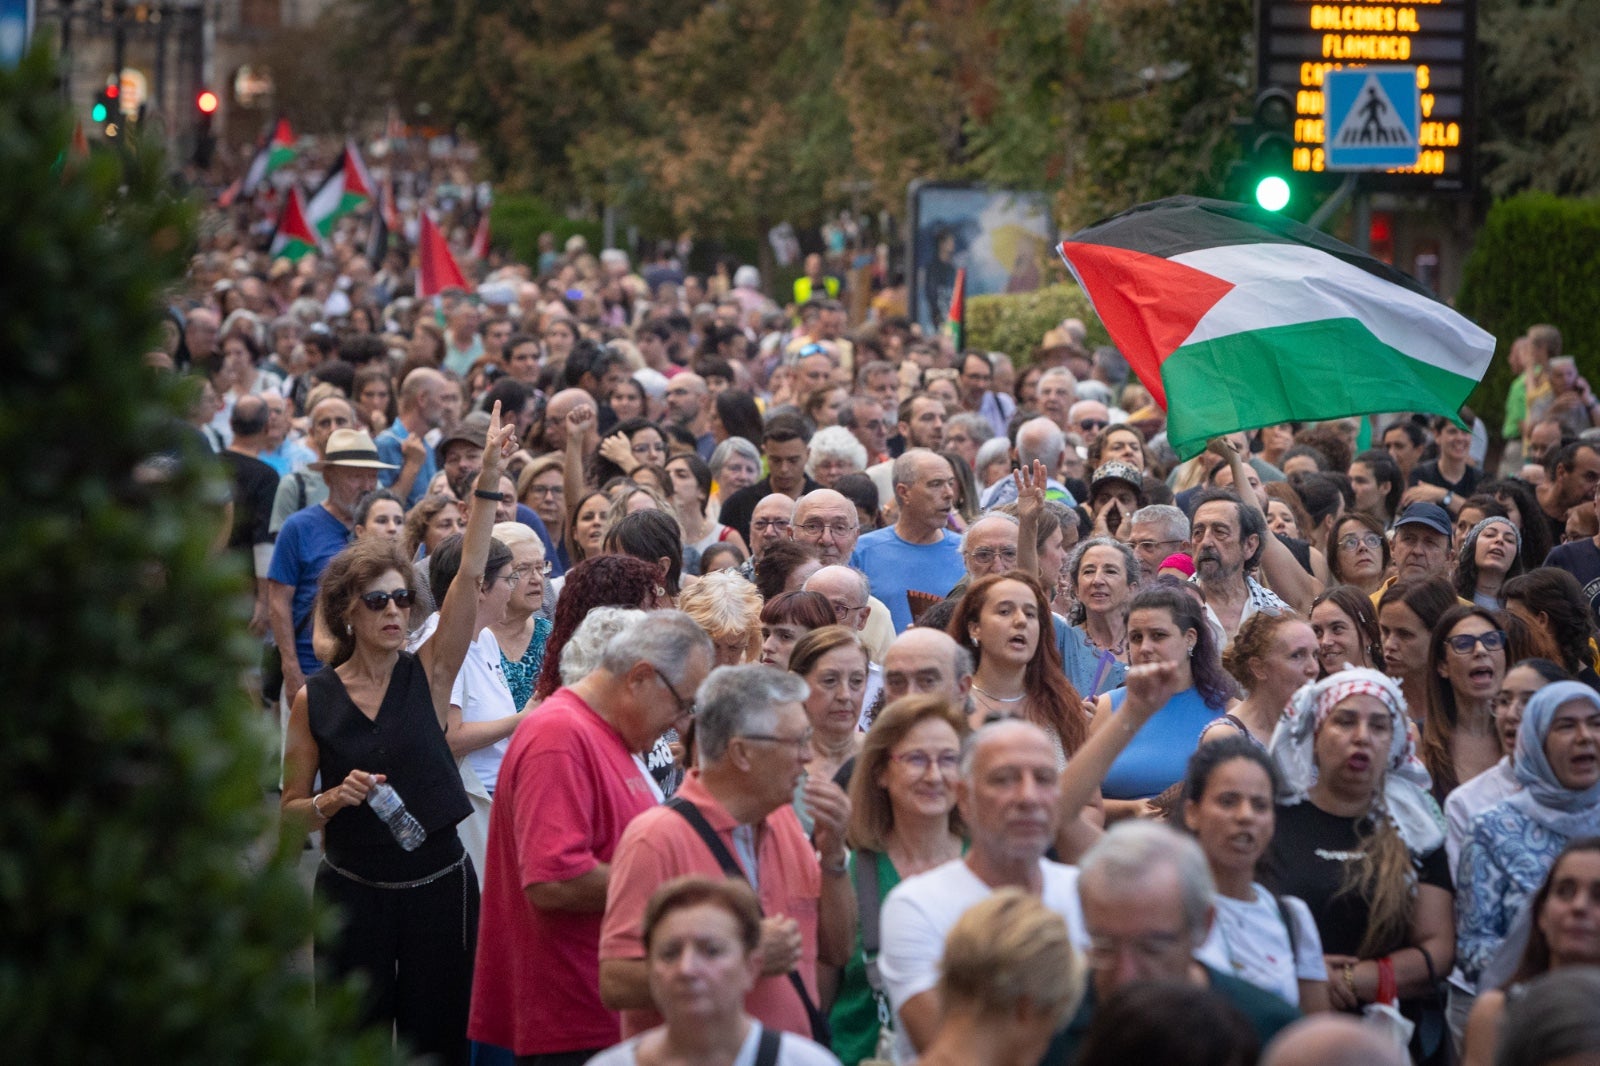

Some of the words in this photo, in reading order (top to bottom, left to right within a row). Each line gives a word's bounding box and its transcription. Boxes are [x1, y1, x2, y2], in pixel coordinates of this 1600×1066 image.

[1310, 5, 1396, 31] BALCONES
[1397, 7, 1420, 32] AL
[1322, 34, 1411, 60] FLAMENCO
[1311, 148, 1325, 172] 2
